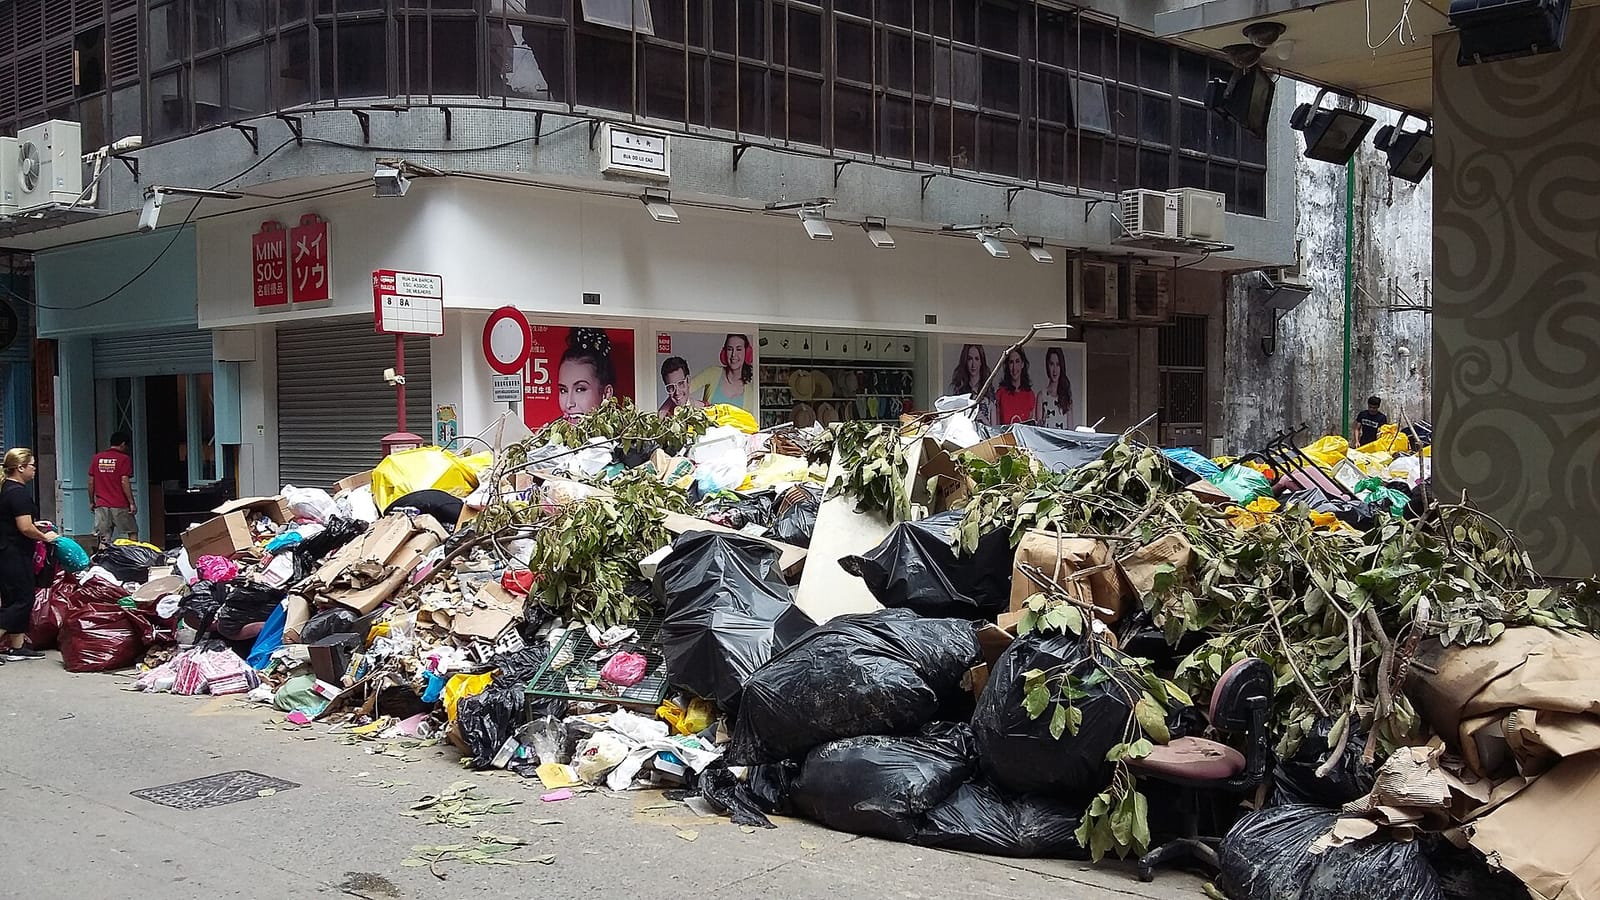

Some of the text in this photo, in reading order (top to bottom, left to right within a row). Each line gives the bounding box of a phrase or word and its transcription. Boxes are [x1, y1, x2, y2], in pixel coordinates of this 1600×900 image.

[256, 240, 282, 261] MINI
[295, 232, 323, 263] メイ
[387, 297, 392, 305] 8
[399, 298, 410, 306] 8A
